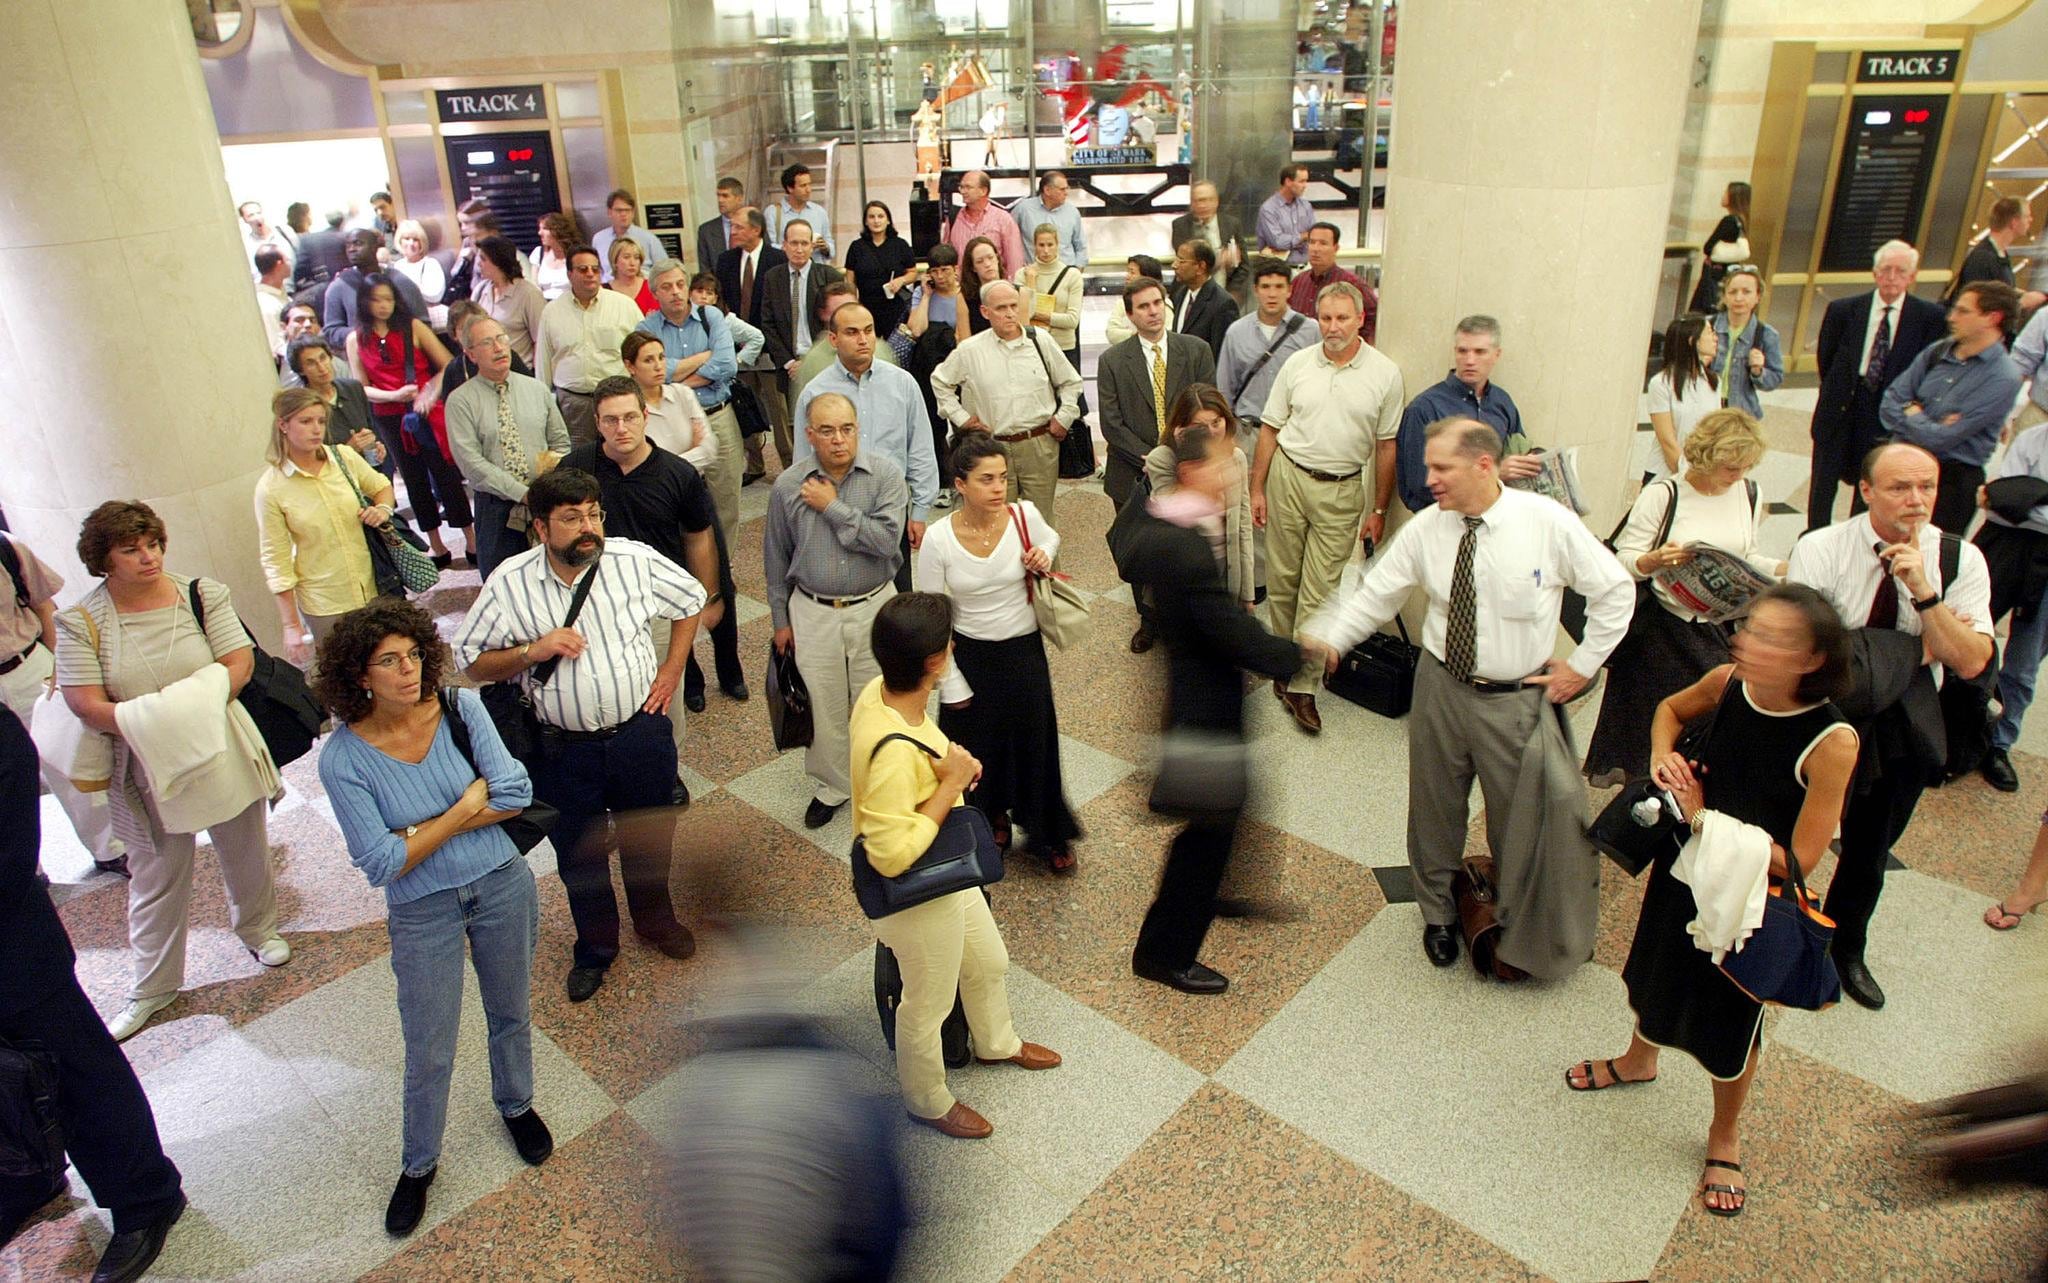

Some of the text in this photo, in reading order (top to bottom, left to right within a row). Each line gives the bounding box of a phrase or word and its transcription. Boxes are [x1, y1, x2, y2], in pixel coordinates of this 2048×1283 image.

[1867, 57, 1949, 76] TRACK 5
[447, 93, 536, 114] TRACK 4
[1073, 148, 1095, 158] CITY
[1703, 569, 1727, 589] 16
